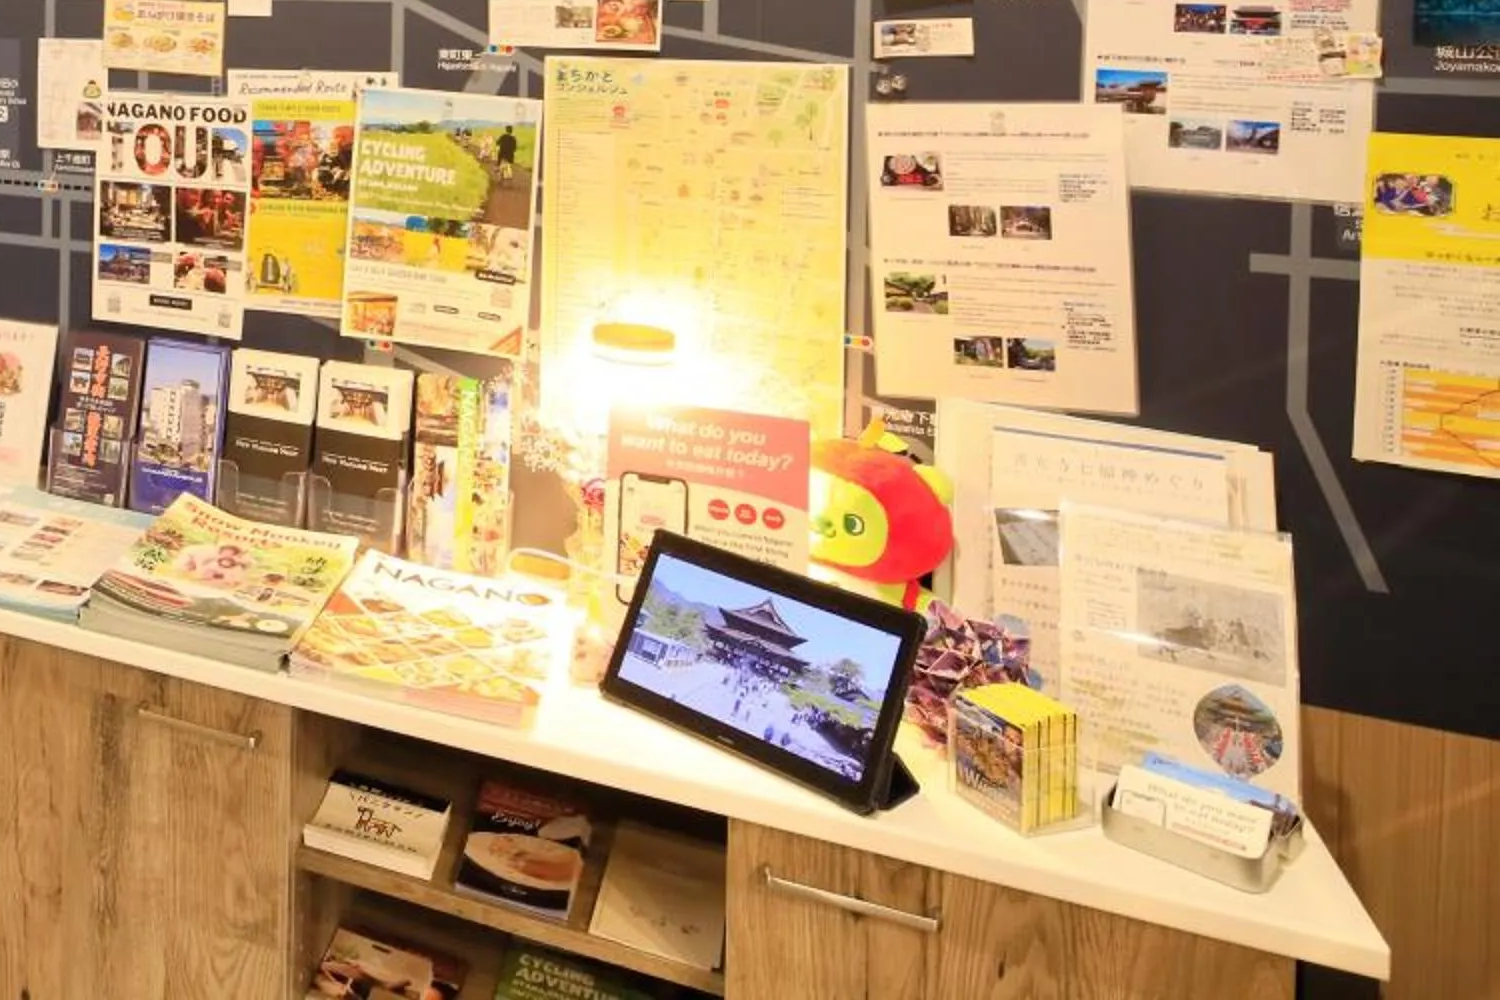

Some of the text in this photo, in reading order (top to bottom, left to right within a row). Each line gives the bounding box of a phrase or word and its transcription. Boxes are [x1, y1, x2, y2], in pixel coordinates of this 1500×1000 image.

[107, 103, 185, 123] NAGANO
[190, 105, 248, 125] FOOD
[107, 121, 249, 183] TOUR
[359, 140, 427, 163] CYCLING
[358, 158, 457, 187] ADVENTURE
[701, 420, 726, 440] do
[728, 426, 768, 449] you
[620, 432, 794, 474] want to eat today?
[373, 560, 553, 608] NAGANO
[518, 953, 596, 987] CYCLING
